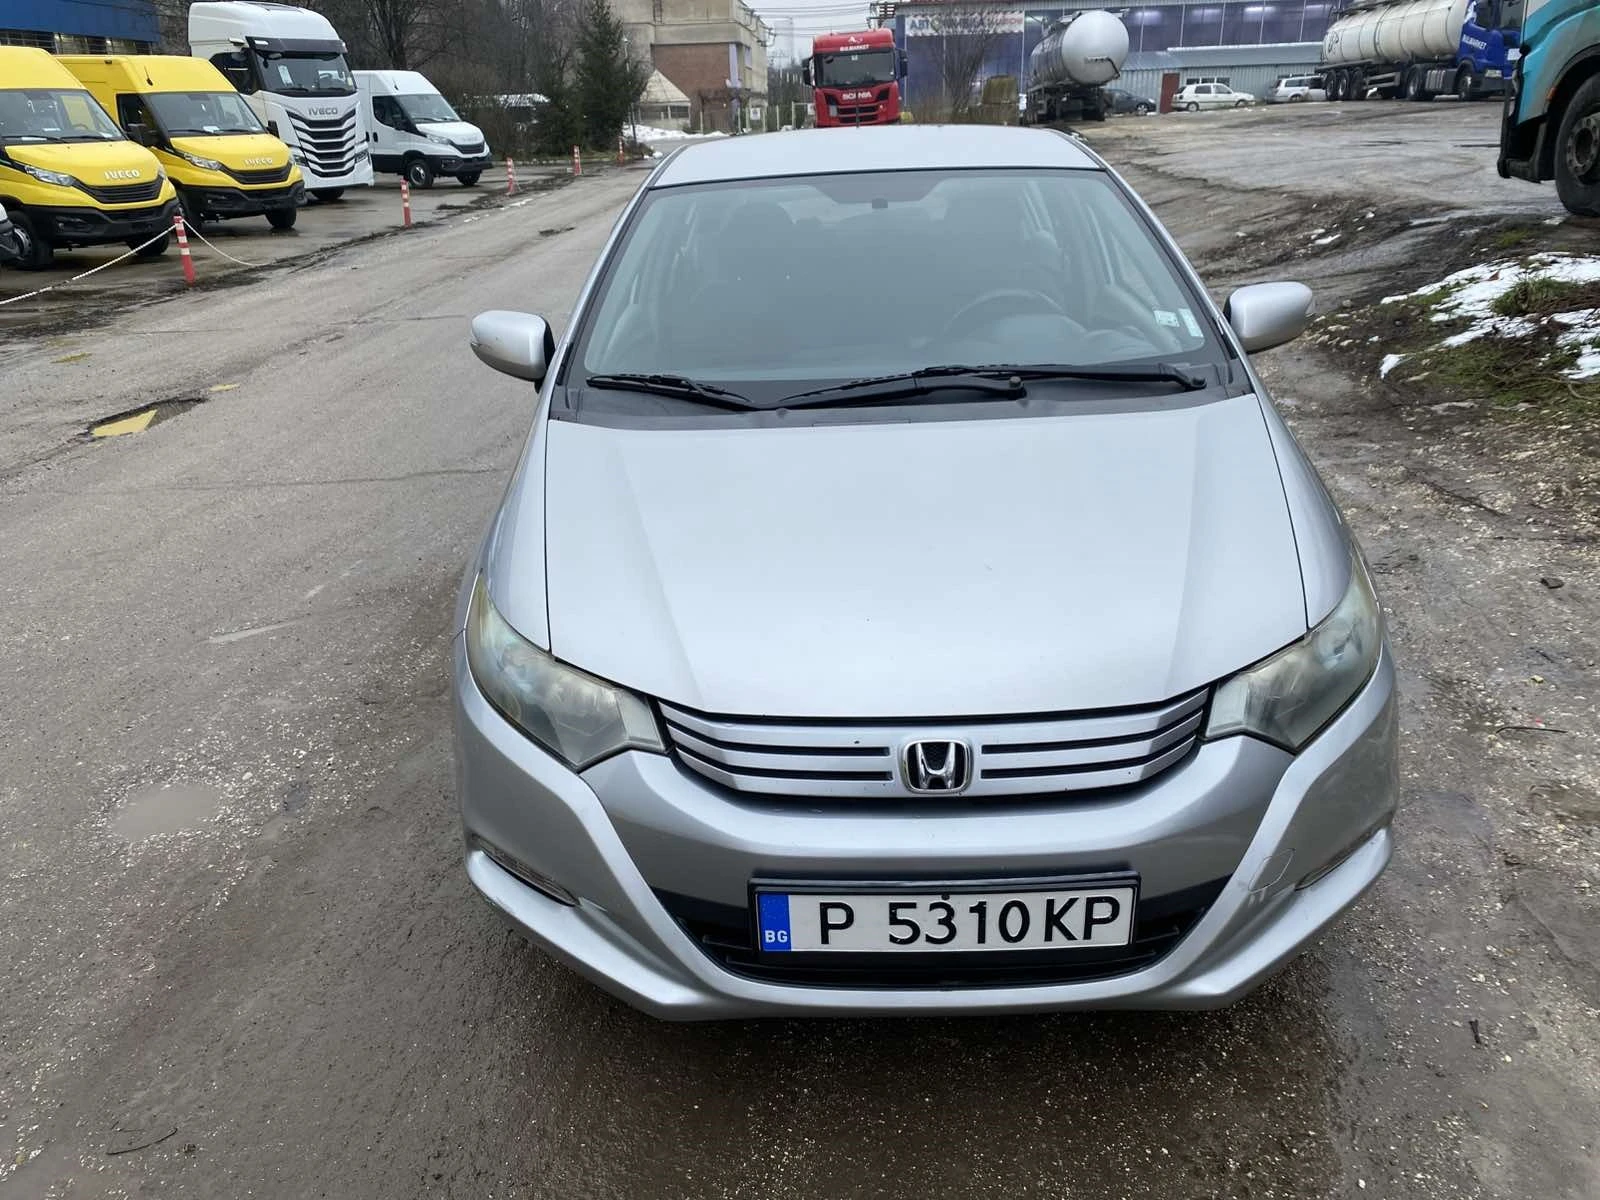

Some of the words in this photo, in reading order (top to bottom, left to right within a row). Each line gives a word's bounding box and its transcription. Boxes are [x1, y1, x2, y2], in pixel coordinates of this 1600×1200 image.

[309, 107, 338, 116] IVECO
[244, 157, 273, 167] IVECO
[104, 169, 141, 180] IVECO
[764, 930, 789, 944] BG
